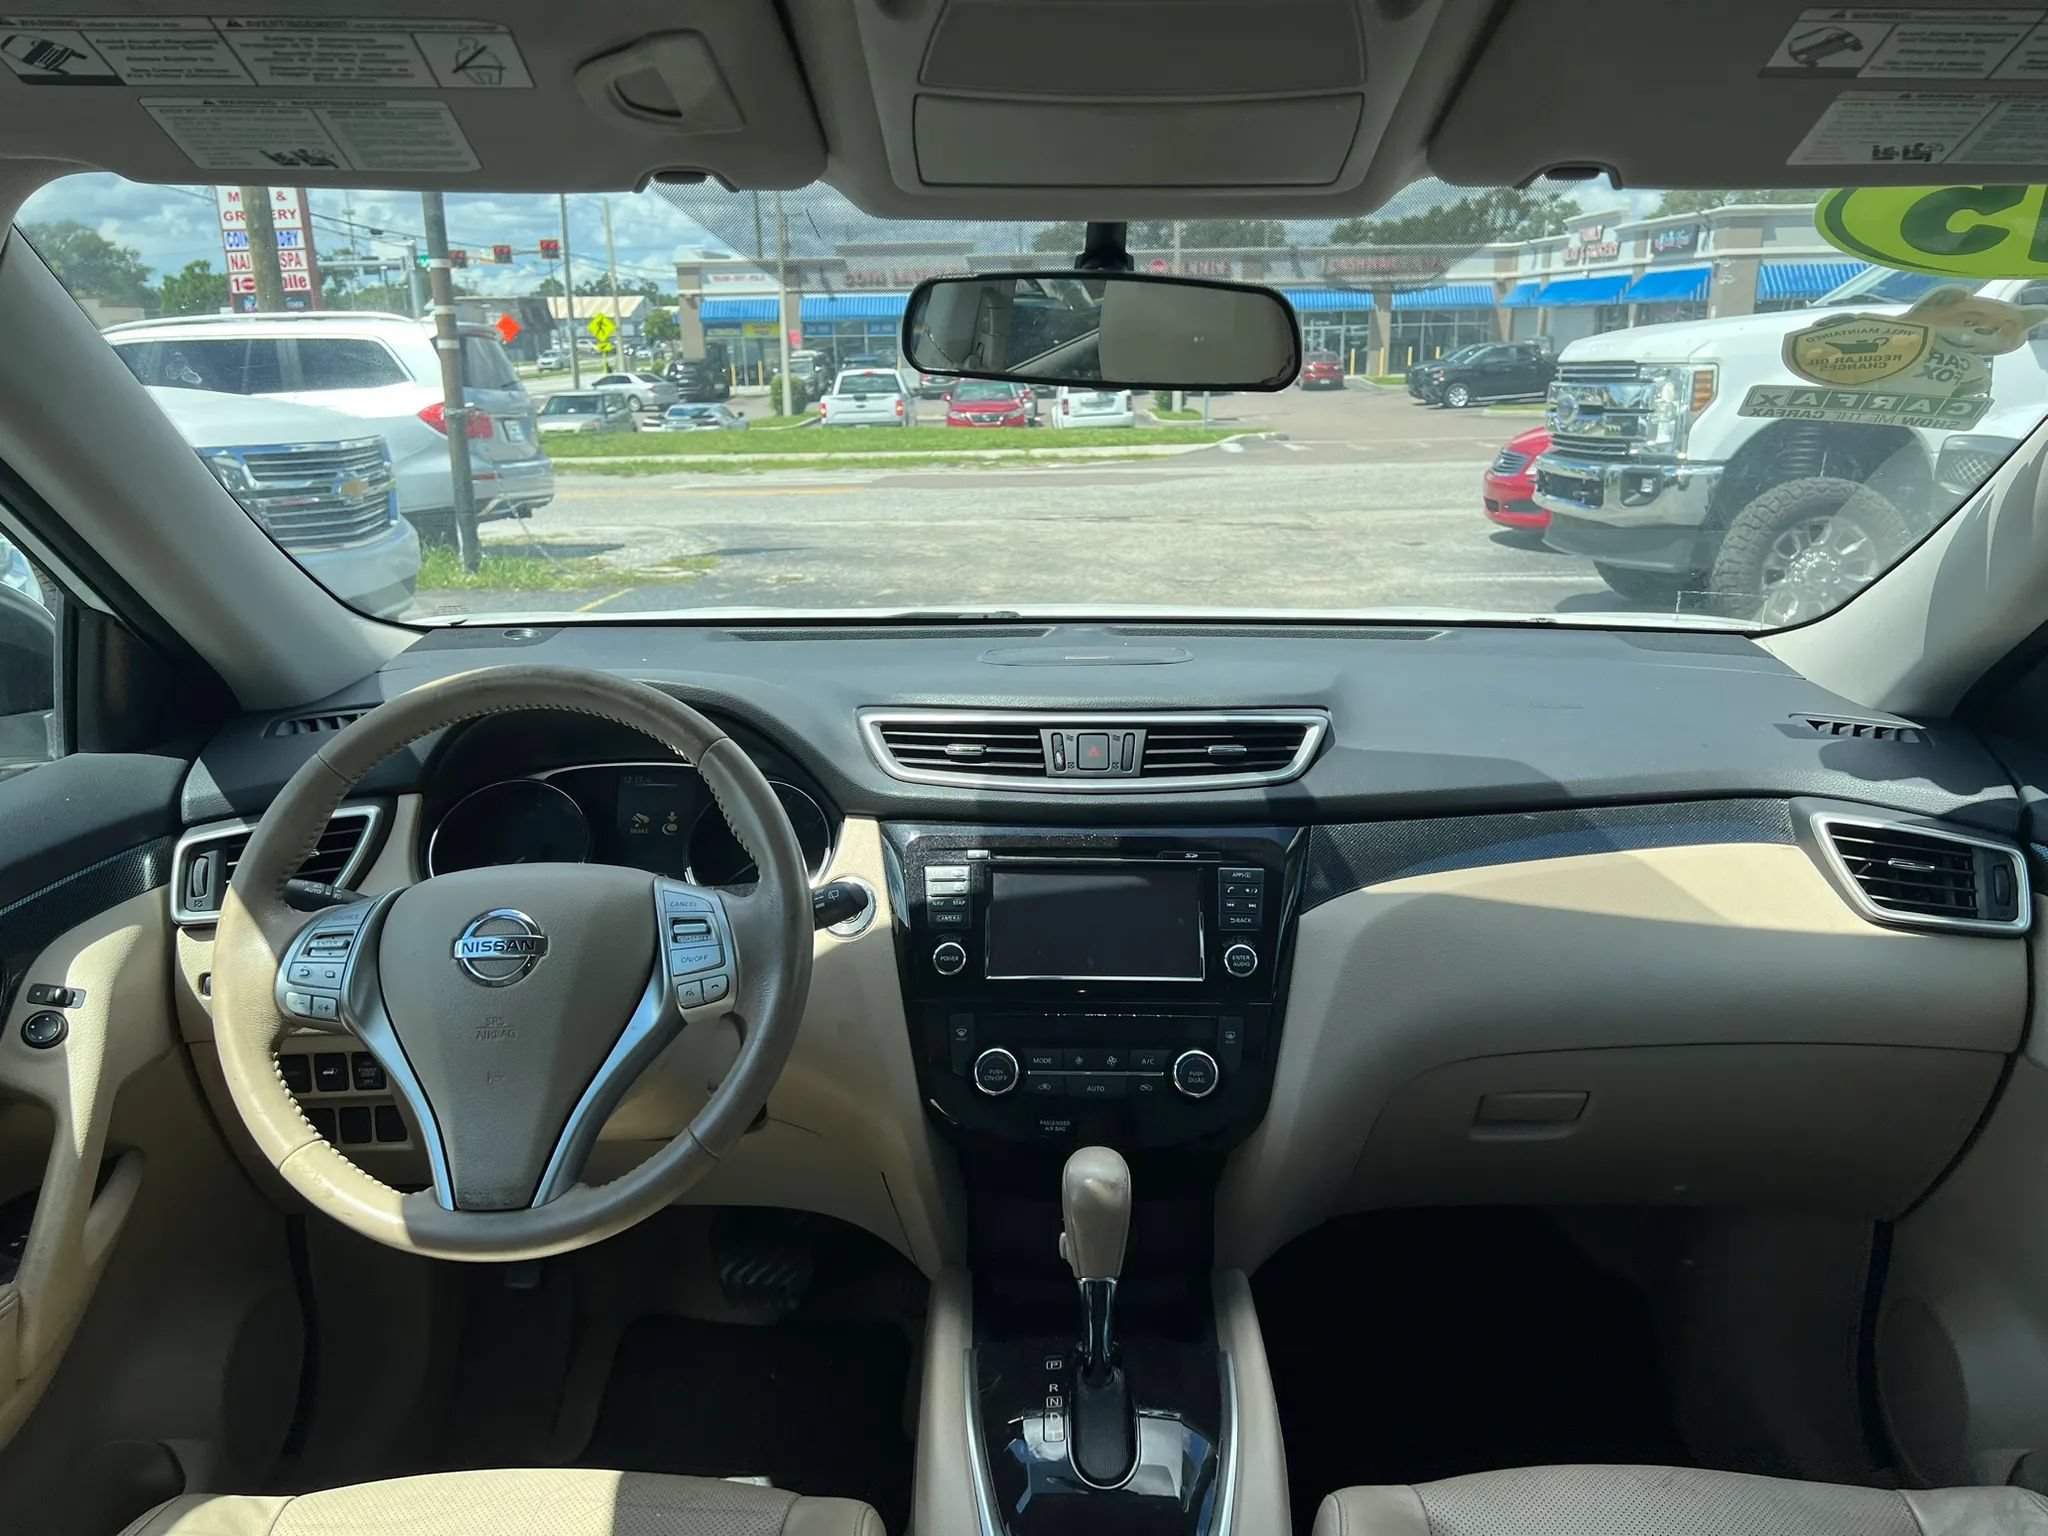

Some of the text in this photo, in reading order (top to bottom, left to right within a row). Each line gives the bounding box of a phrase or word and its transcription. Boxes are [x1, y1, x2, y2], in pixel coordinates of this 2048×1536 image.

[280, 252, 302, 268] SPA
[304, 887, 322, 895] AUTO
[462, 940, 535, 953] NISSAN
[681, 954, 708, 963] ON/OFF
[1141, 1058, 1155, 1066] A/C
[1049, 1383, 1058, 1392] R
[1050, 1397, 1059, 1406] N
